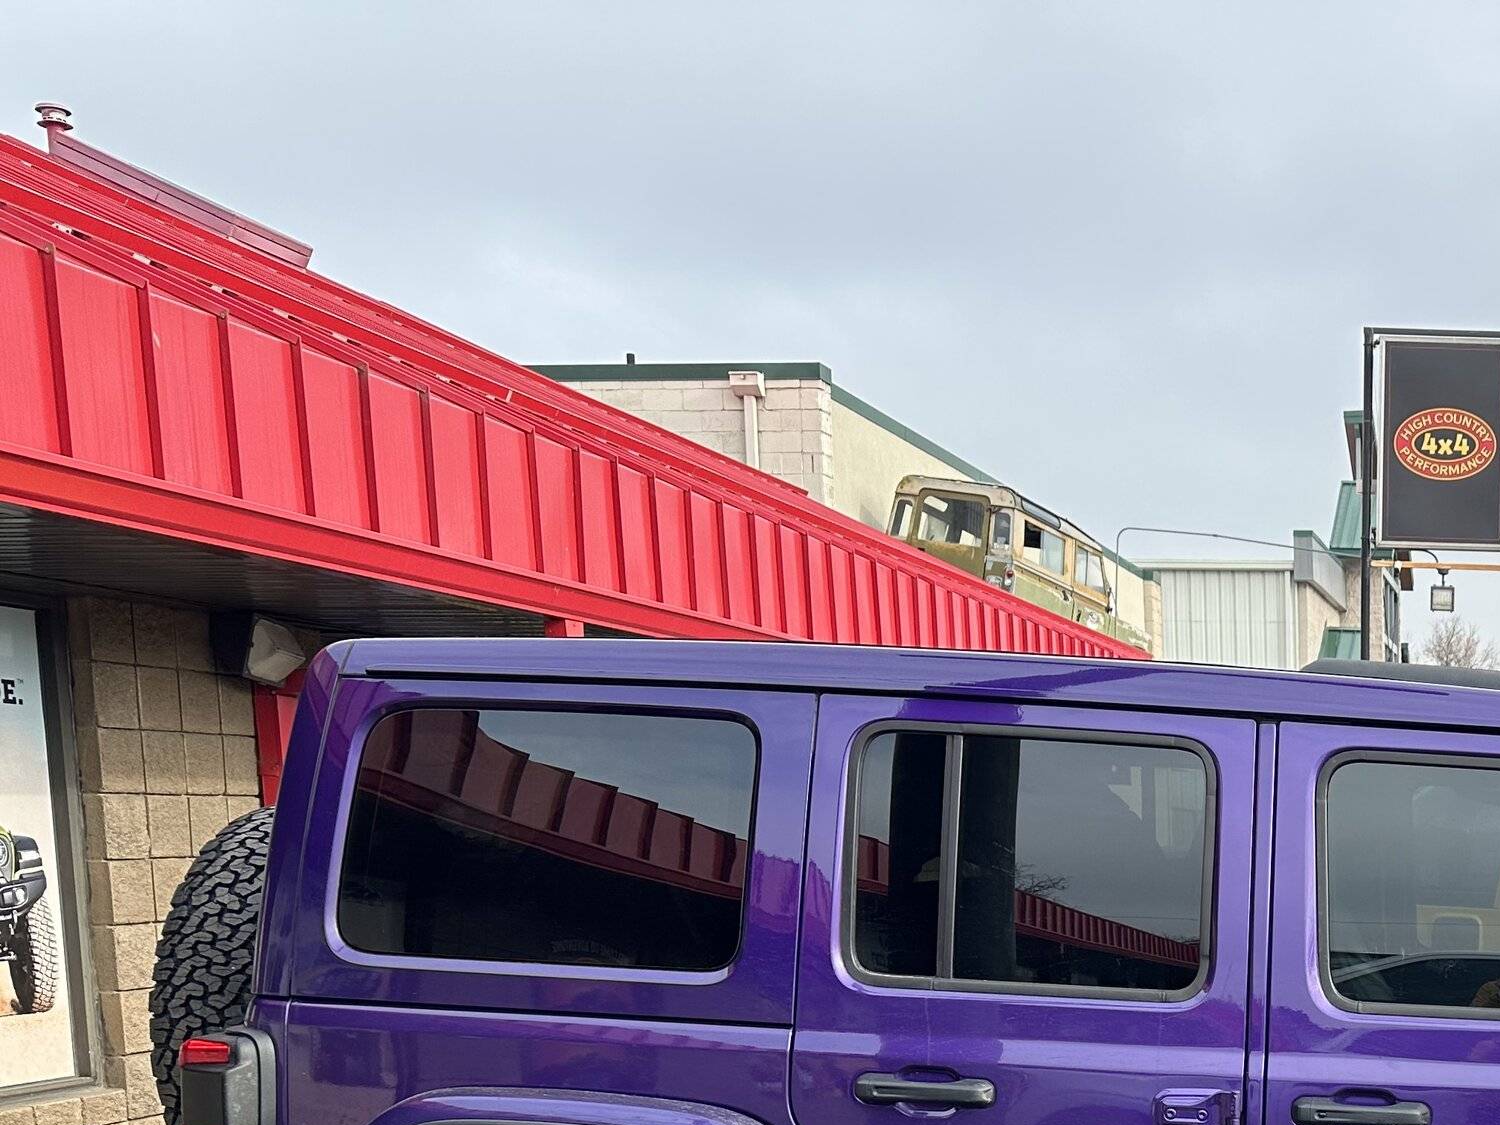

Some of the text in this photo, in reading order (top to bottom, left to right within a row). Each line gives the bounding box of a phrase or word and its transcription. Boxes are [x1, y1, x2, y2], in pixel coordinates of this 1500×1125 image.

[1400, 412, 1493, 442] HIGH COUNTRY
[1421, 432, 1470, 456] 4x4
[1399, 446, 1492, 475] PERFORMANCE
